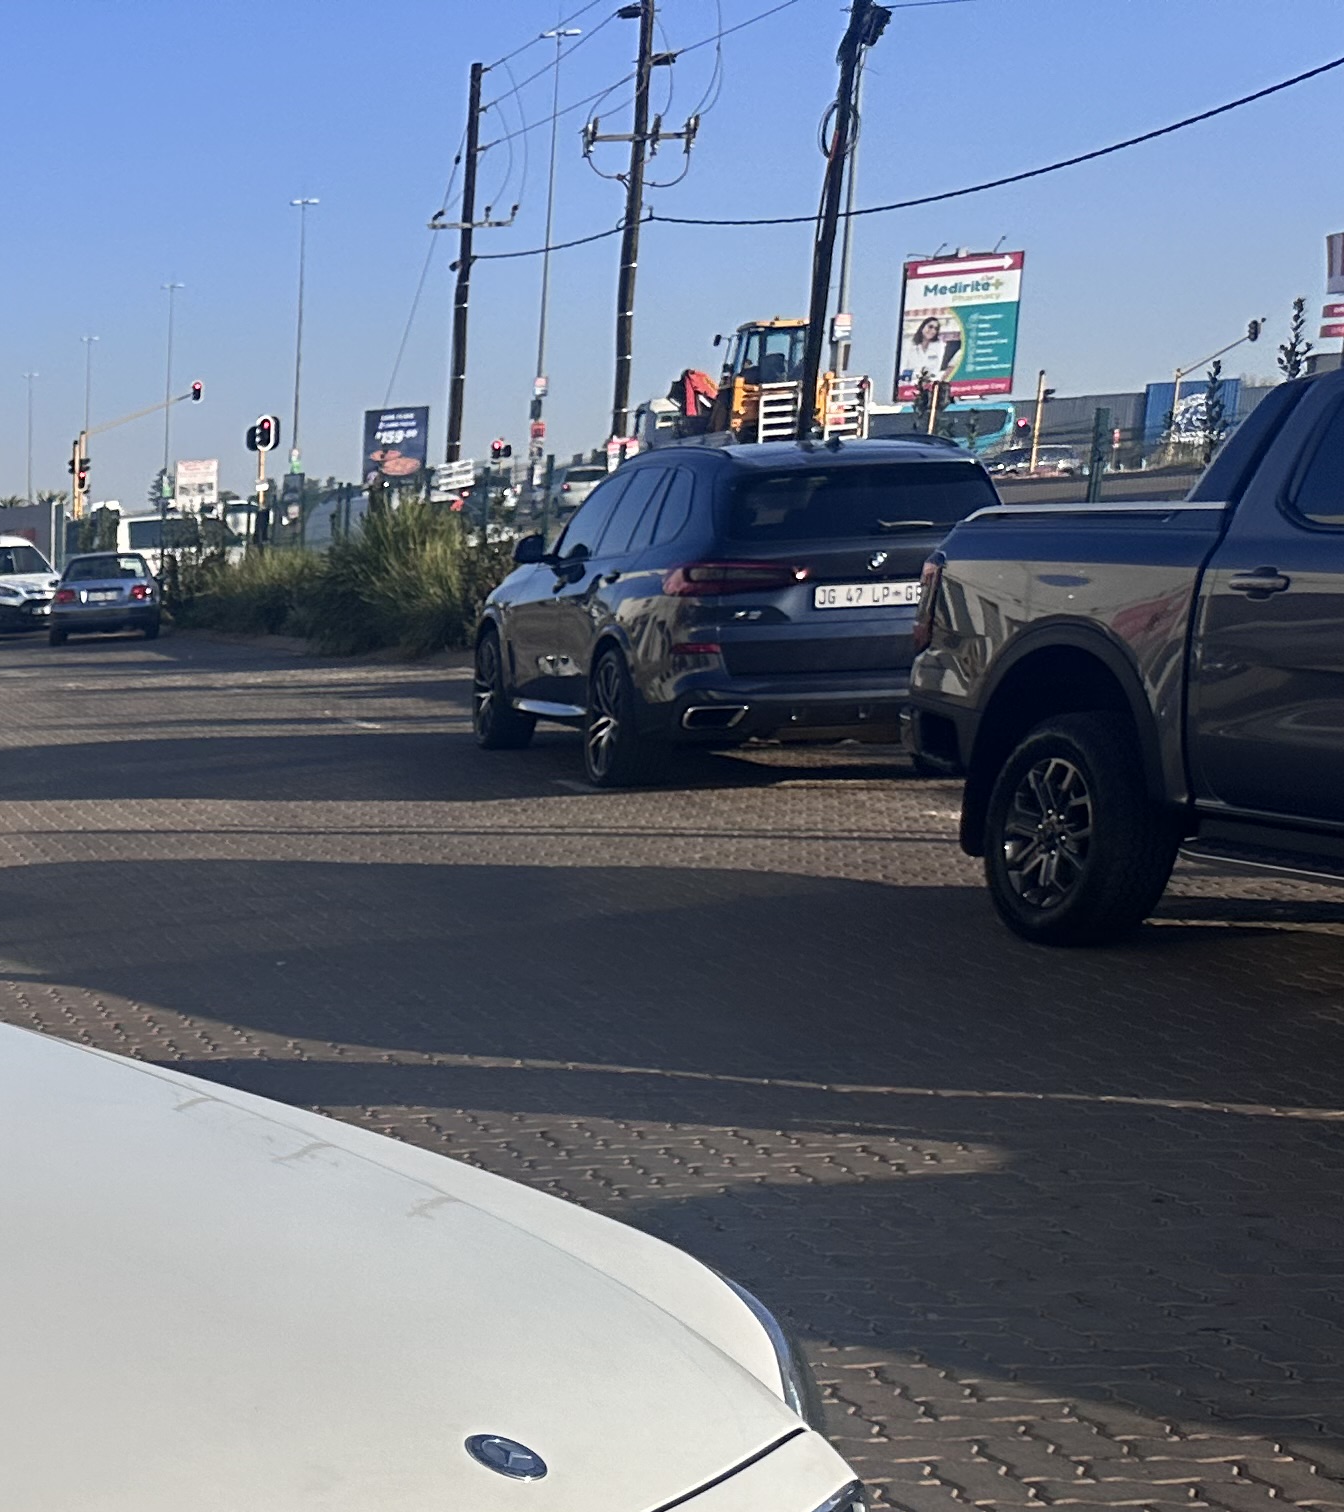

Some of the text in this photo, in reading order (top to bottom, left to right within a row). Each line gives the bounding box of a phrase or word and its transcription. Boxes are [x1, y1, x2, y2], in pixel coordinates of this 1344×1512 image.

[819, 589, 836, 605] JG
[846, 587, 863, 604] 47
[872, 586, 889, 602] LP
